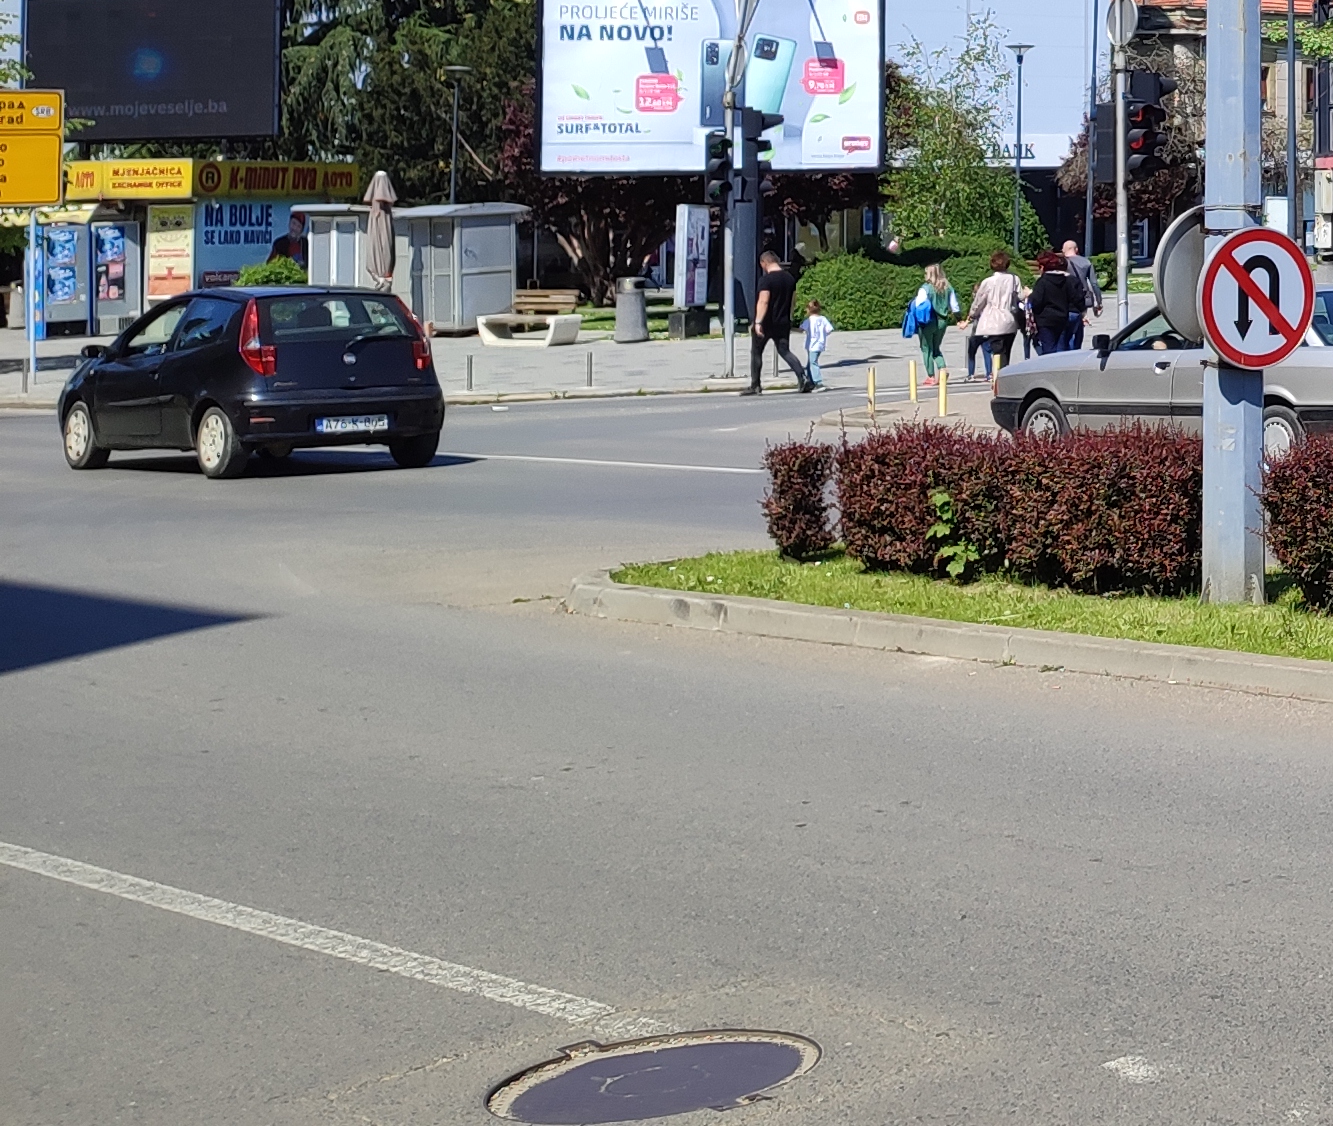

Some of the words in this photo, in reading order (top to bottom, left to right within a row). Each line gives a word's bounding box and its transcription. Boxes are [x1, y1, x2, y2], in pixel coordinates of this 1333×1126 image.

[559, 2, 638, 20] PROLJEĆE
[645, 2, 699, 21] MIRIŠE
[559, 25, 592, 41] NA
[599, 25, 673, 42] NOVO!
[68, 98, 228, 120] www.mojeveselje.ba
[112, 165, 182, 177] MJENJAČNICA
[204, 205, 224, 227] NA
[228, 204, 273, 227] BOLJE
[204, 230, 216, 245] SE
[218, 230, 241, 245] LAKO
